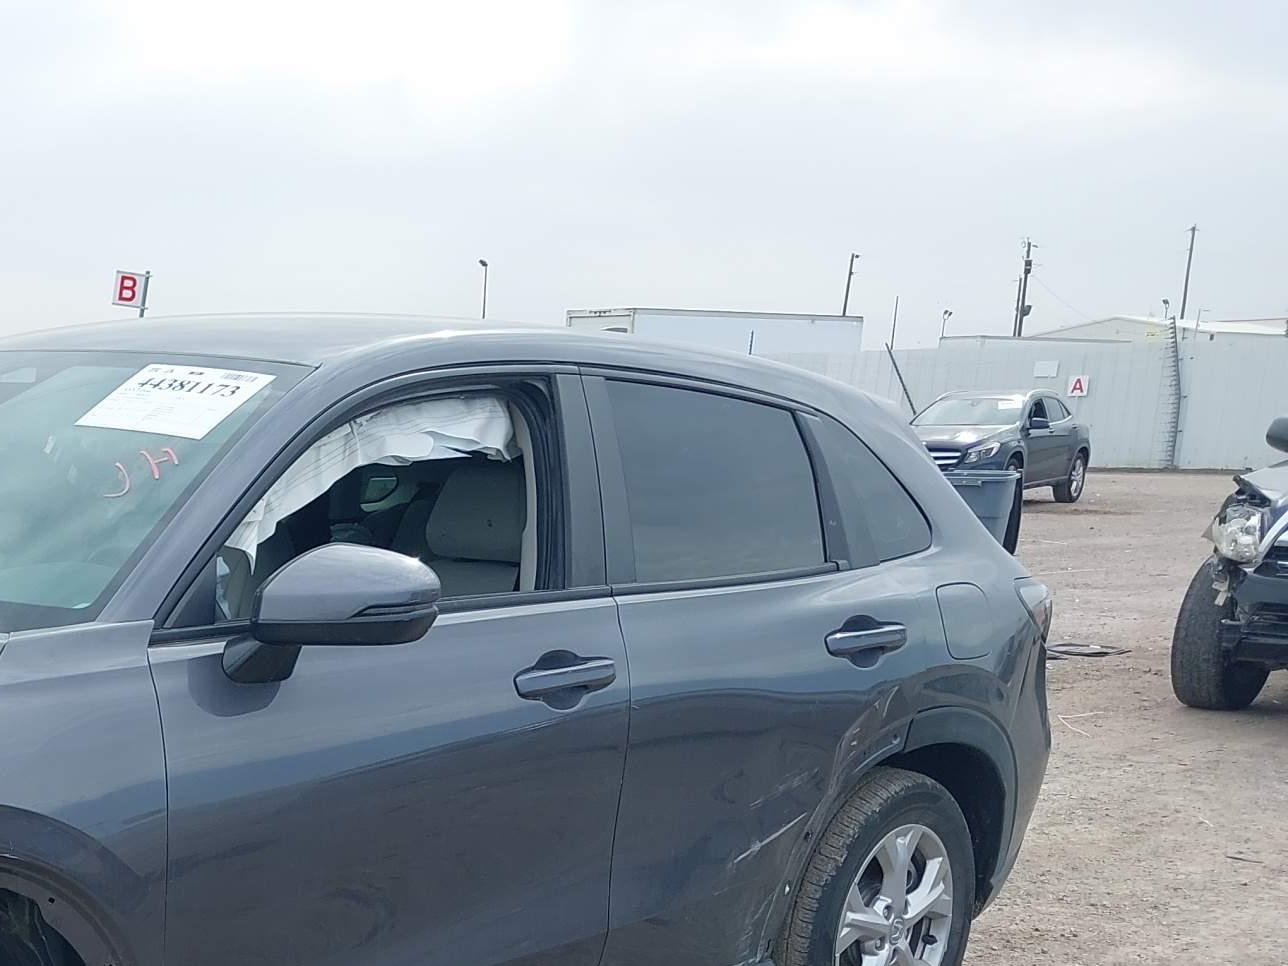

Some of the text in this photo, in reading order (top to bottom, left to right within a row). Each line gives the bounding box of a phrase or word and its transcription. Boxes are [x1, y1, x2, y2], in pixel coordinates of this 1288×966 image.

[118, 275, 137, 302] B
[138, 377, 241, 398] 44381173
[1071, 378, 1084, 394] A
